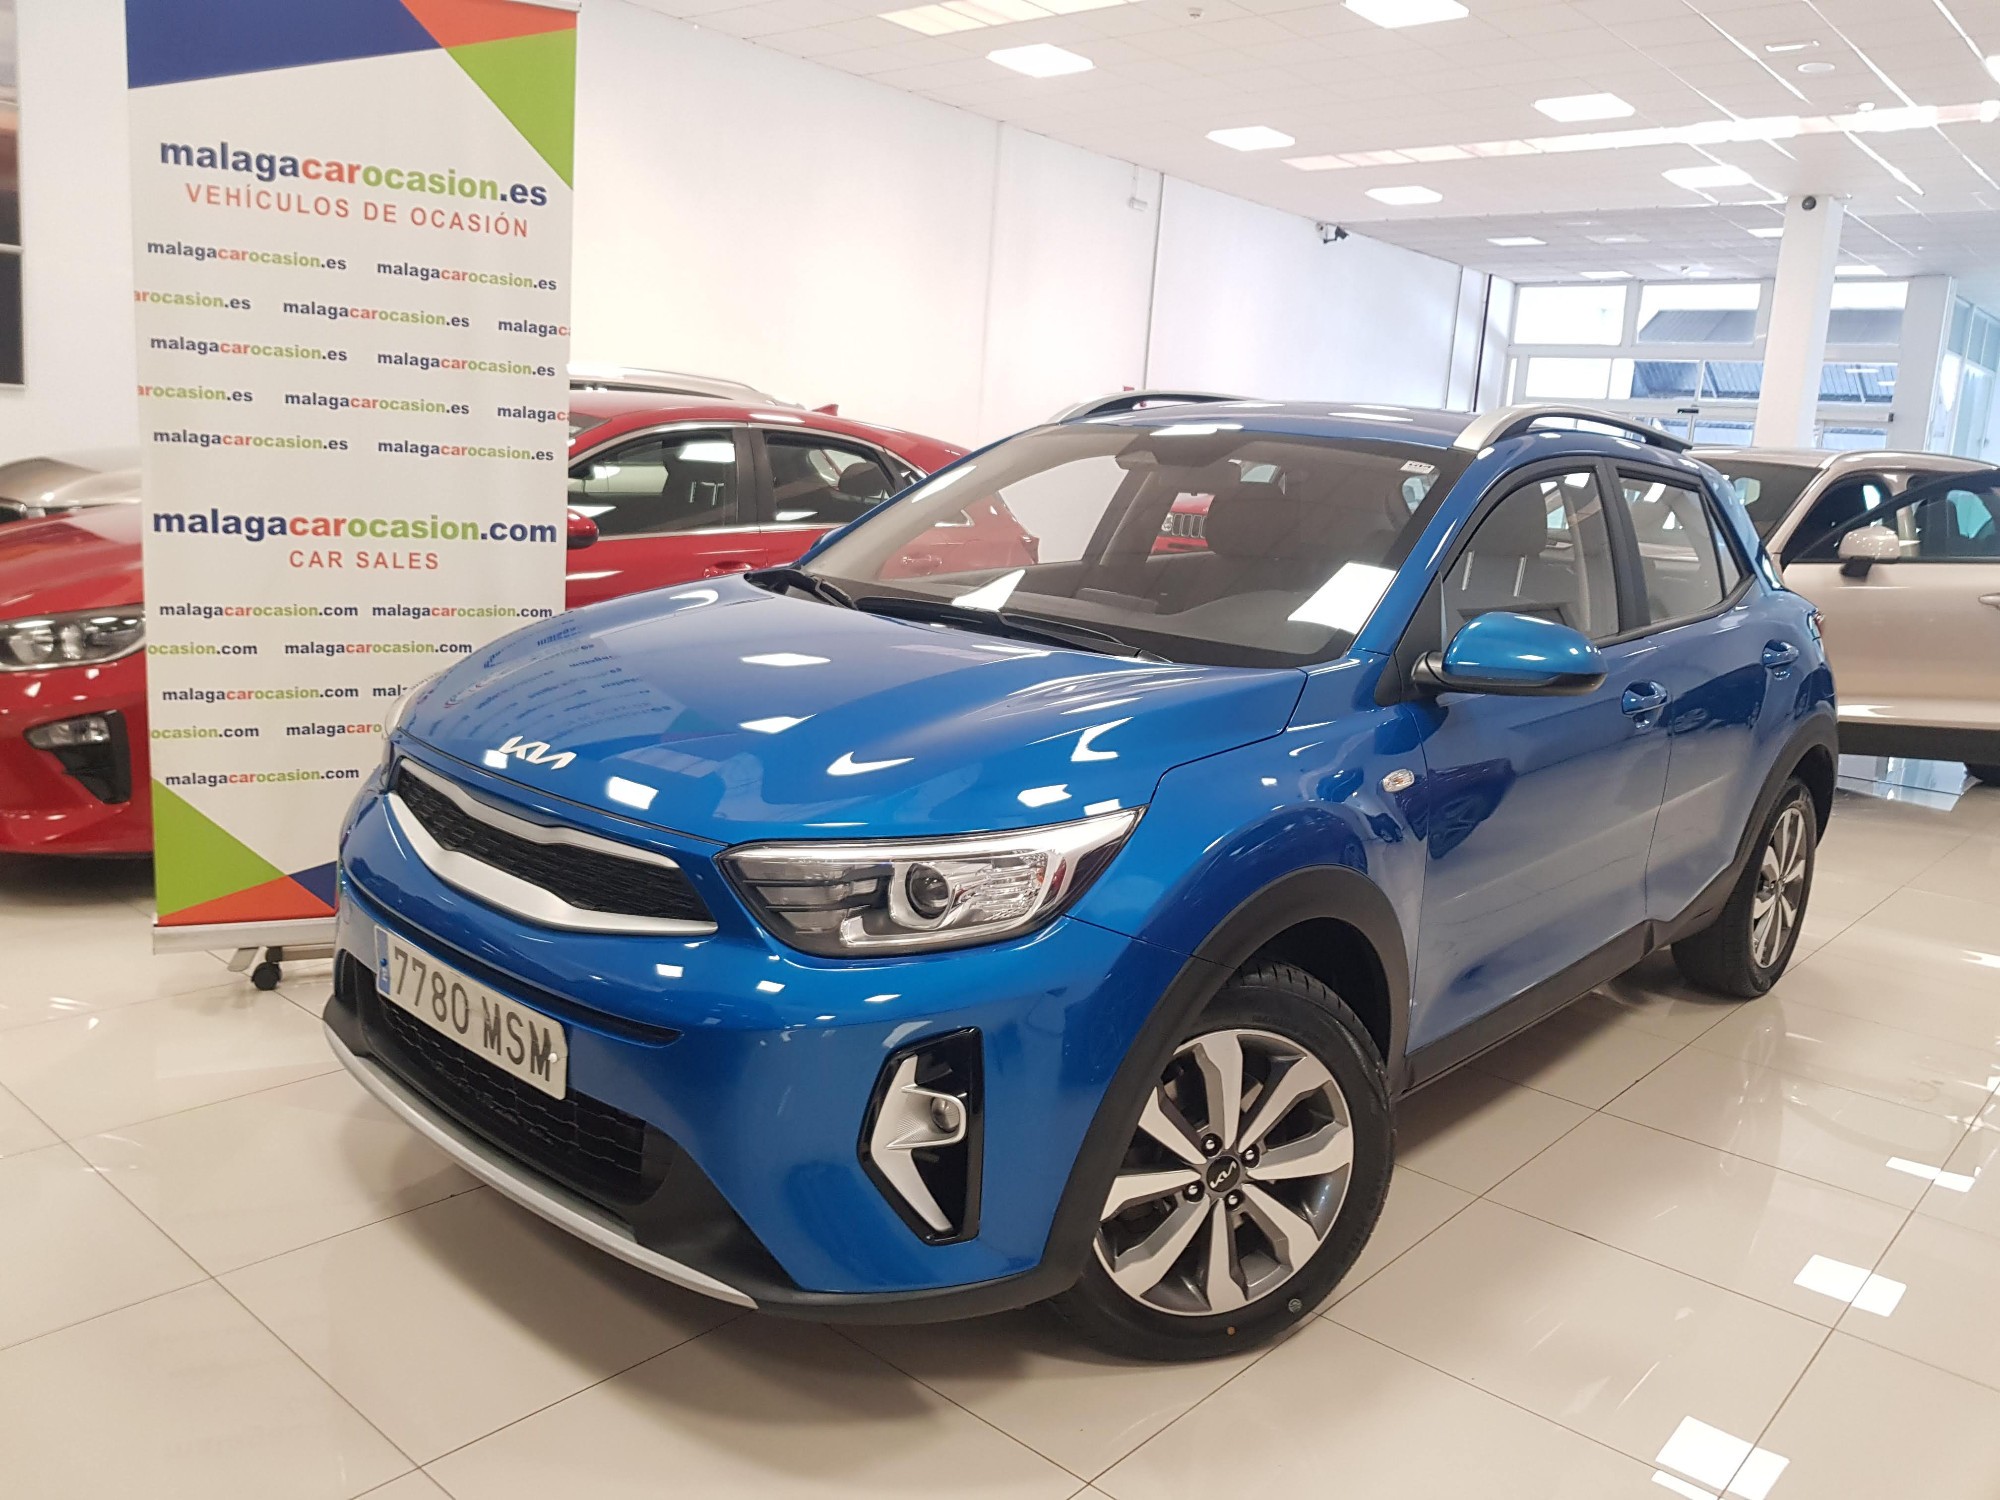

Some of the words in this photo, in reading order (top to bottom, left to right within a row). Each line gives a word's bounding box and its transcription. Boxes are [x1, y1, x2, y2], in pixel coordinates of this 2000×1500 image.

[160, 141, 548, 207] malagacarocasion.es
[185, 183, 350, 218] VEHÍCULOS
[364, 201, 397, 223] DE
[410, 207, 528, 237] OCASIÓN
[147, 241, 347, 270] malagacarocasion.es
[377, 261, 557, 290] malagacarocasion.es
[283, 301, 470, 327] malagacarocasion.es
[498, 319, 570, 338] malagac
[150, 336, 348, 361] malagacarocasion.es
[377, 352, 556, 377] malagacarocasion.es
[284, 392, 470, 415] malagacarocasion.es
[497, 406, 569, 423] malagac
[153, 429, 349, 451] malagacarocasion.es
[377, 440, 554, 461] malagacarocasion.es
[152, 508, 557, 543] malagacarocasion.com
[288, 550, 343, 569] CAR
[355, 551, 439, 570] SALES
[159, 603, 359, 619] malagacarocasion.com
[372, 604, 553, 619] malagacarocasion.com
[147, 641, 258, 655] ocasion.com
[284, 642, 472, 656] malagacarocasion.com
[162, 687, 359, 703] malagacarocasion.com
[372, 684, 408, 697] mal
[150, 725, 260, 739] ocasion.com
[165, 768, 360, 786] malagacarocasion.com
[394, 946, 470, 1035] 7780
[481, 995, 553, 1082] MSM
